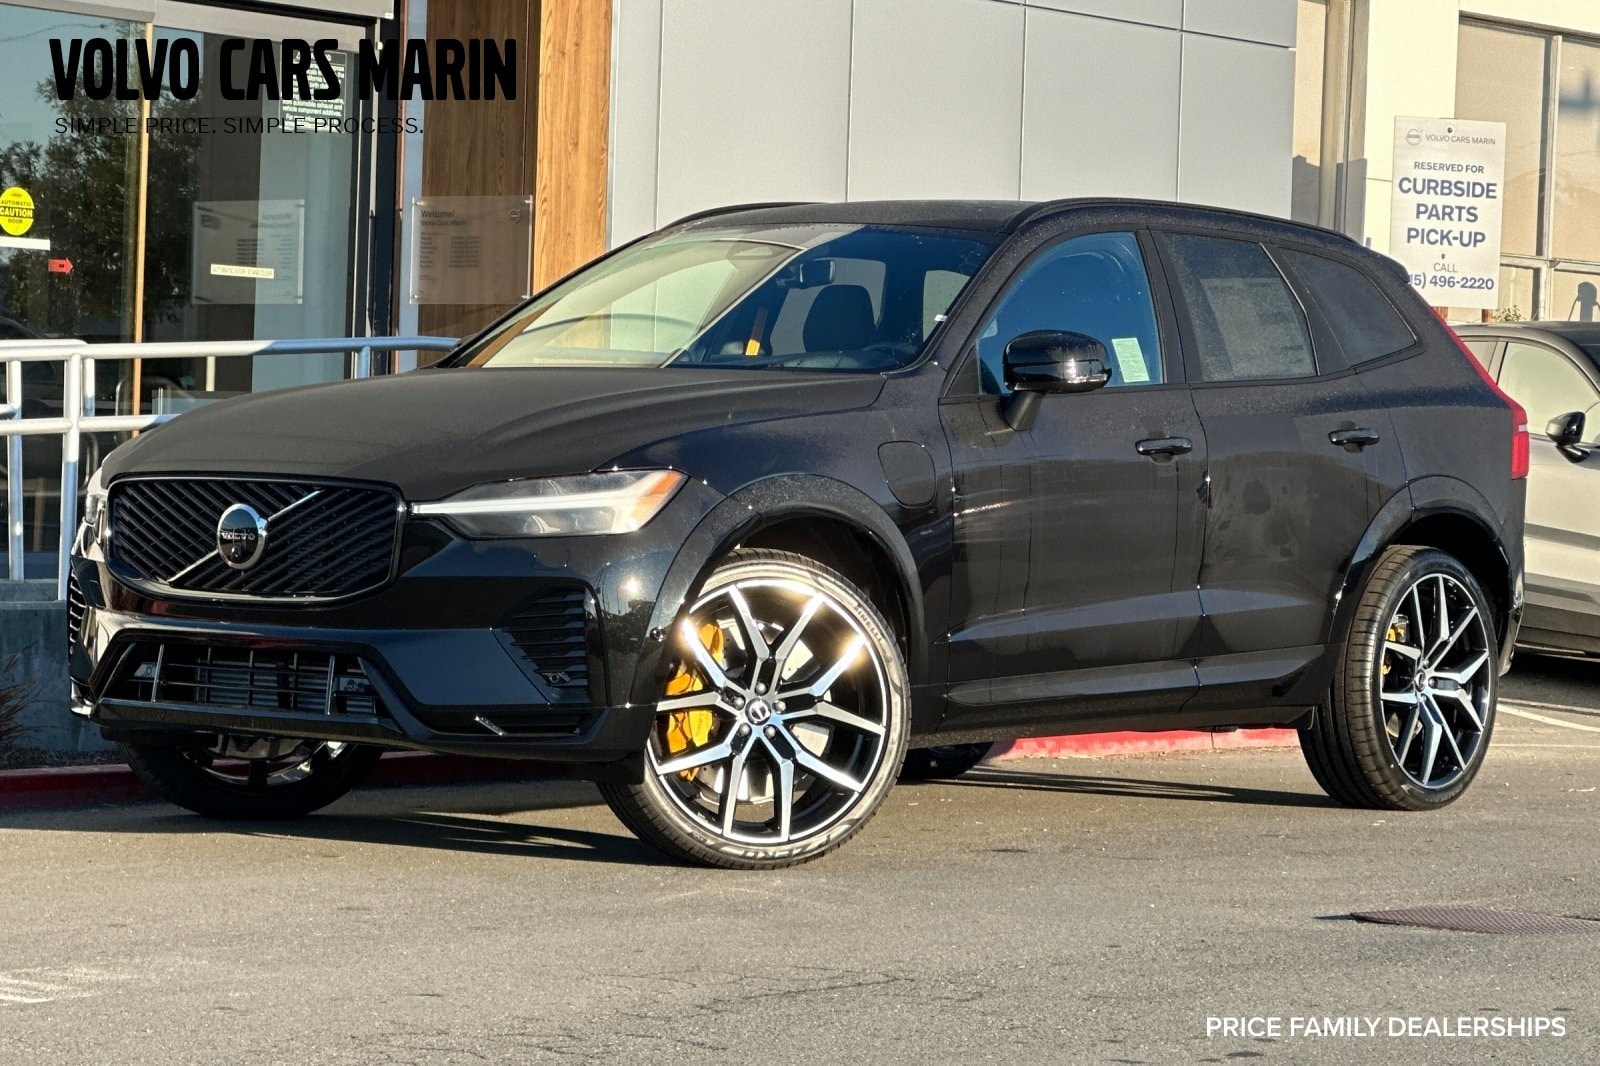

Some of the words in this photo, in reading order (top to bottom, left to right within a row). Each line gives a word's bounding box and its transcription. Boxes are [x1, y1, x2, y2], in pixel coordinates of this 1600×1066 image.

[1426, 133, 1450, 143] VOLVO
[1451, 135, 1471, 144] CARS
[1472, 137, 1496, 145] MARIN
[1414, 161, 1464, 172] RESERVED
[1465, 164, 1485, 174] FOR
[1398, 177, 1497, 199] CURBSIDE
[0, 207, 33, 218] CAUTION
[1416, 203, 1479, 223] PARTS
[1406, 227, 1486, 248] PICK-UP
[1433, 262, 1458, 273] CALL
[1429, 275, 1495, 290] 496-2220
[221, 532, 256, 541] VOLVO
